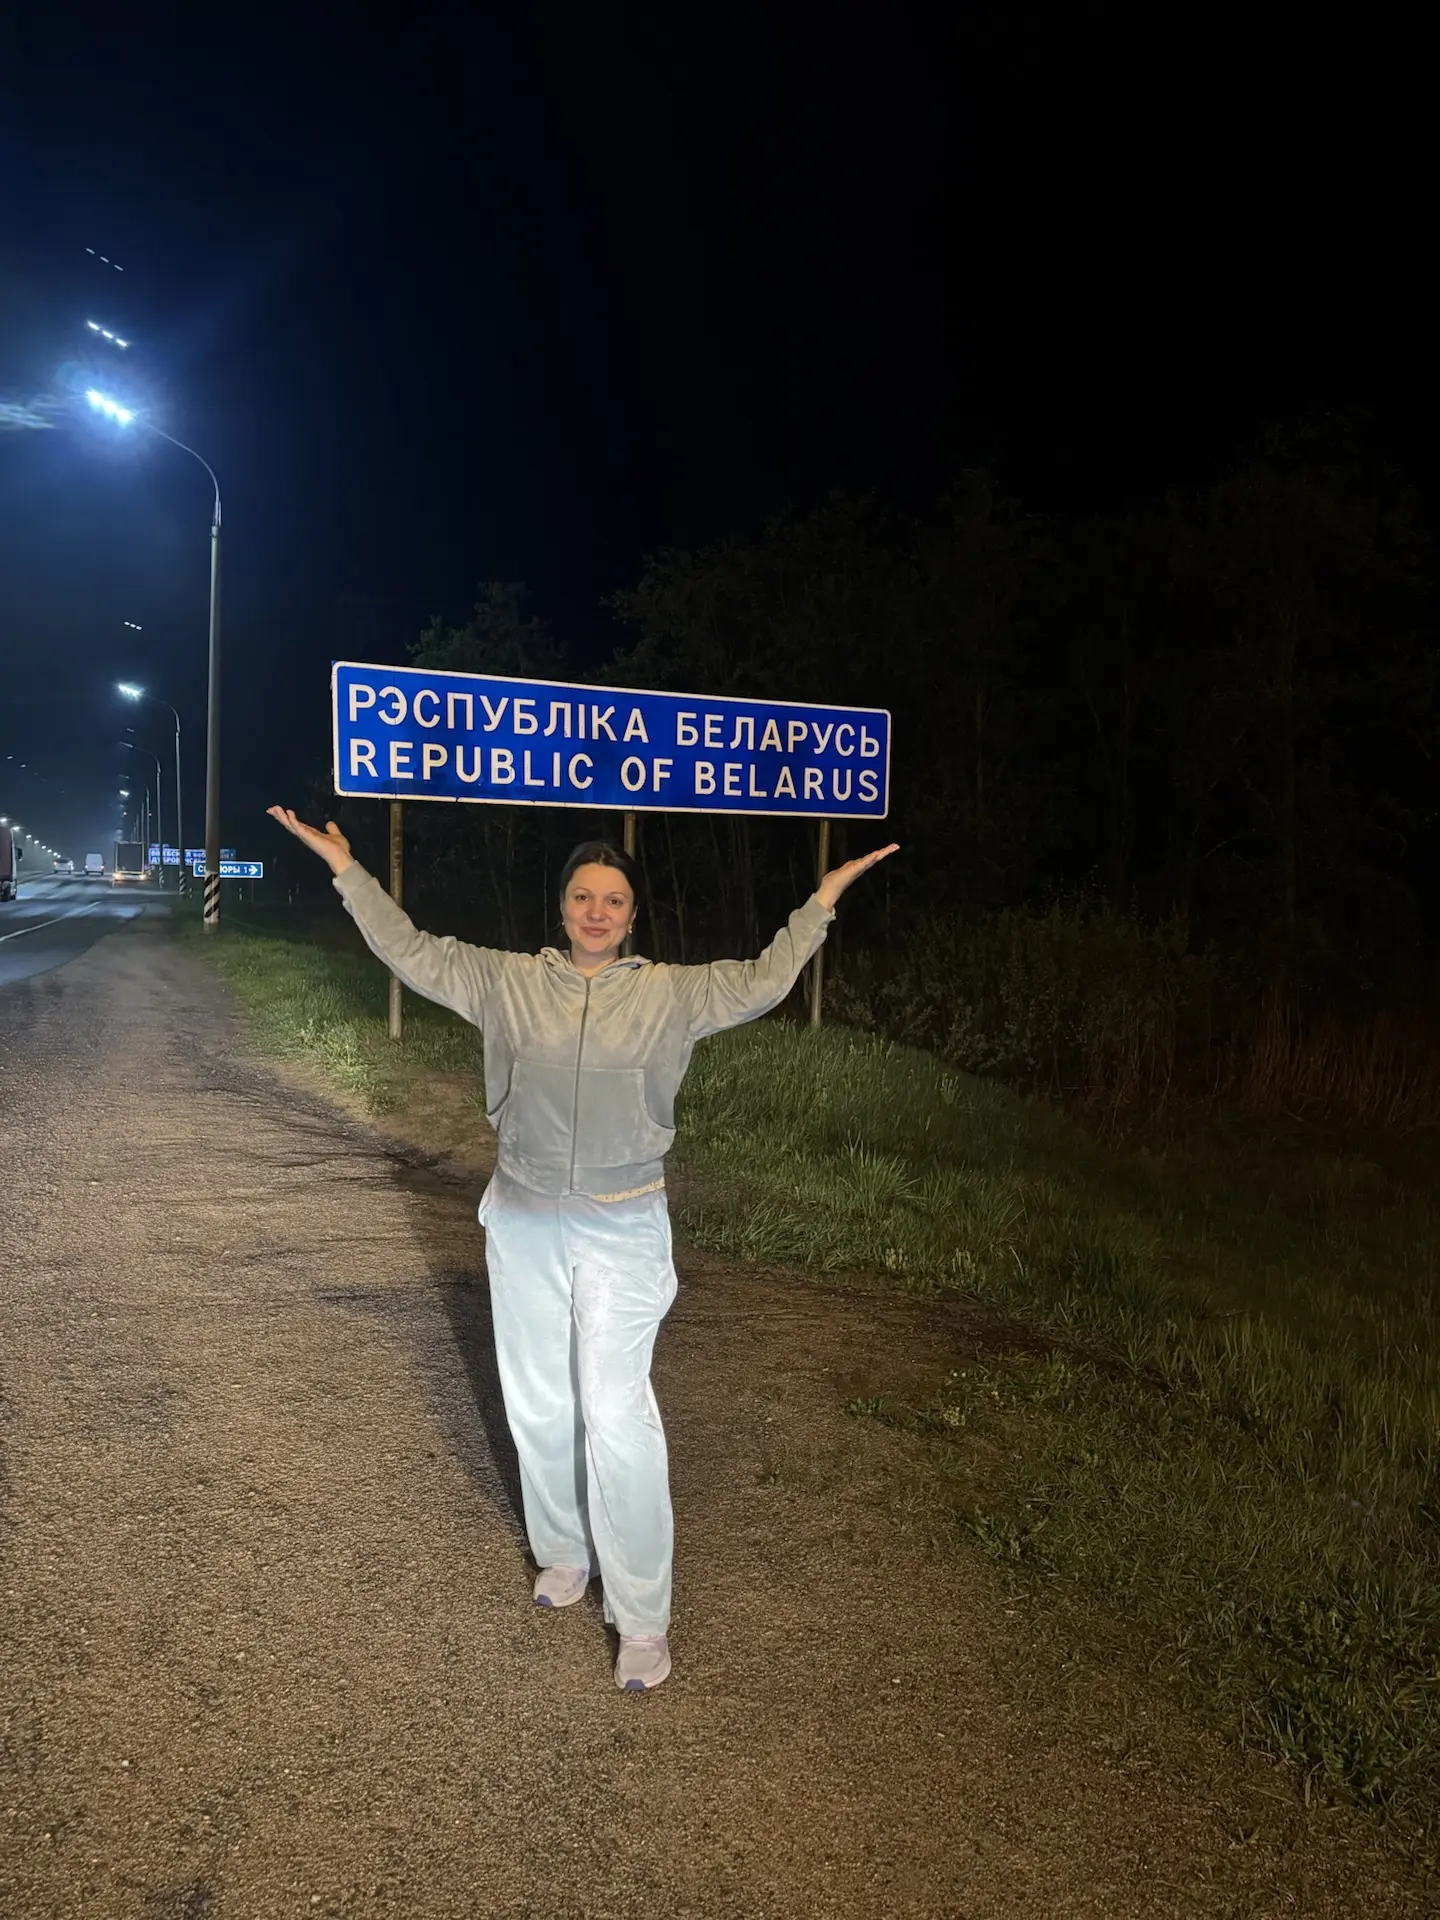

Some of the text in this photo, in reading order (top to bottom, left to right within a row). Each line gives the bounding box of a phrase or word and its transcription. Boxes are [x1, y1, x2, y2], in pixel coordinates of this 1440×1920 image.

[348, 683, 881, 758] РЭСПУБЛІКА БЕЛАРУСЬ
[349, 738, 880, 803] REPUBLIC OF BELARUS
